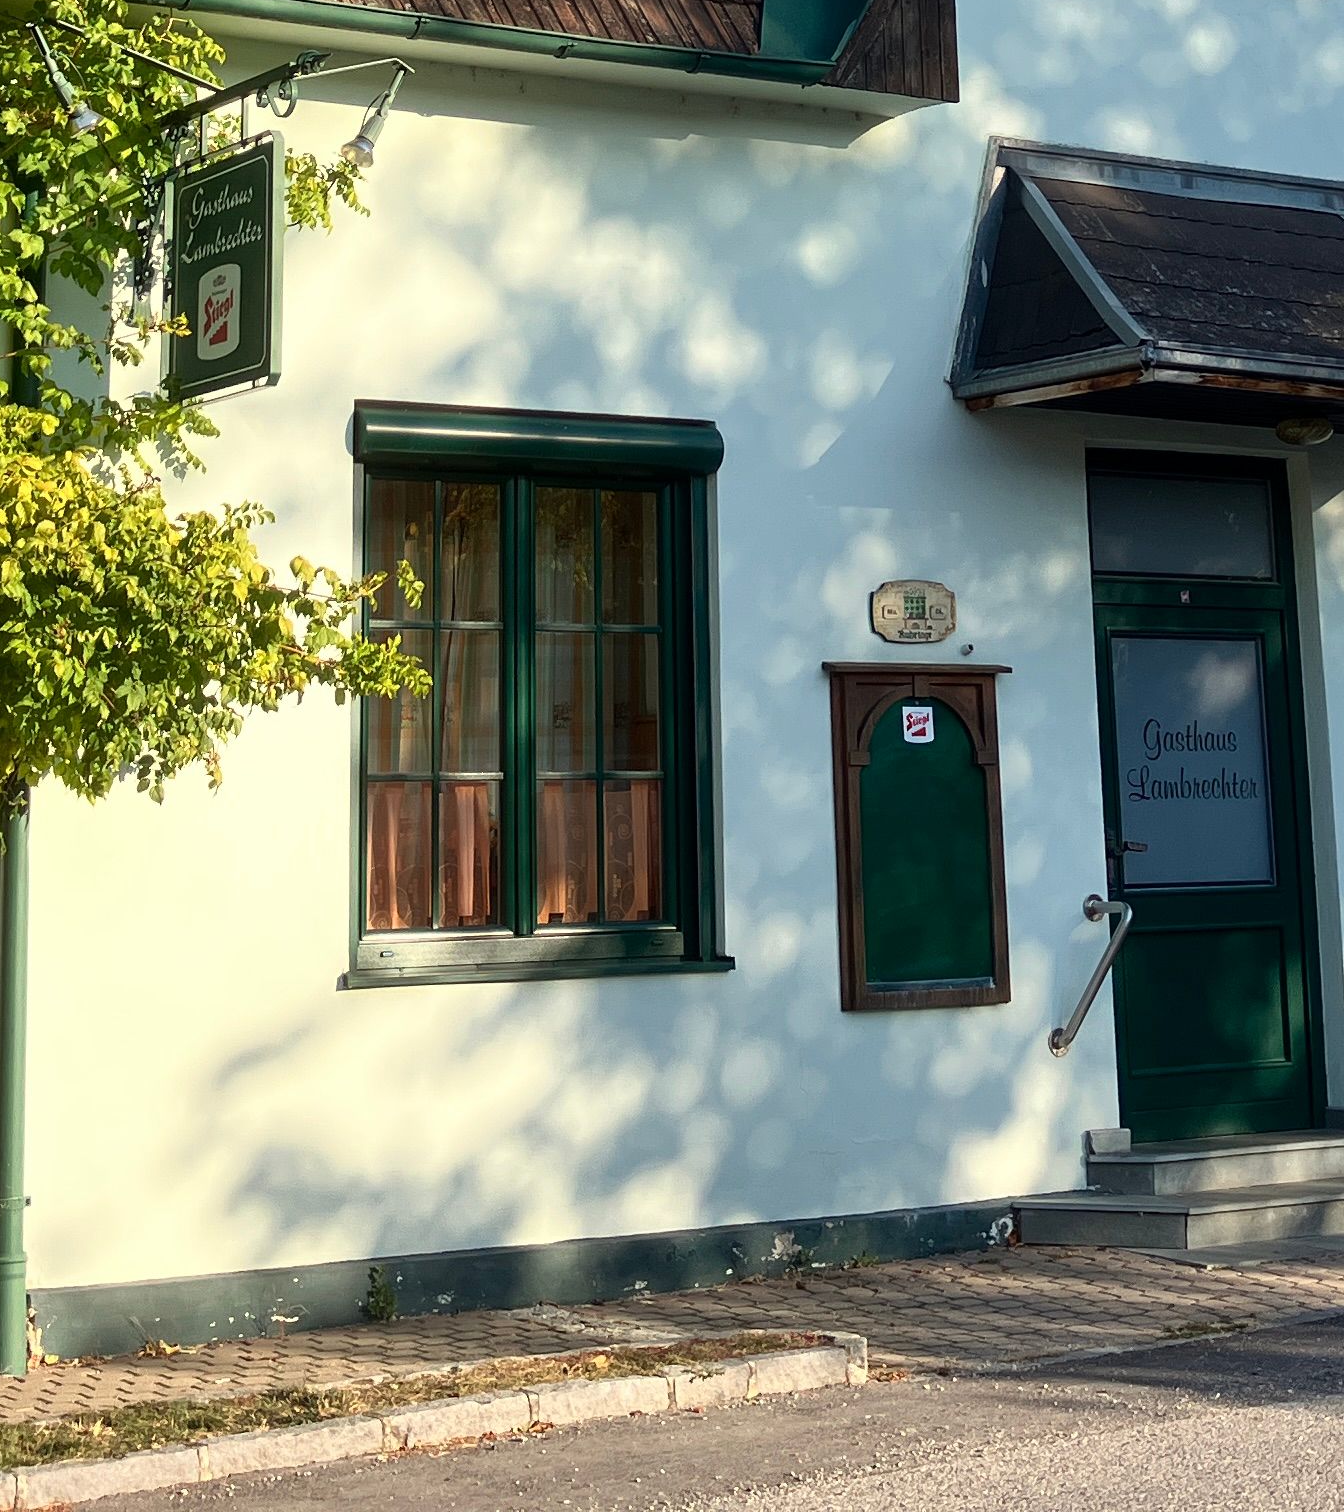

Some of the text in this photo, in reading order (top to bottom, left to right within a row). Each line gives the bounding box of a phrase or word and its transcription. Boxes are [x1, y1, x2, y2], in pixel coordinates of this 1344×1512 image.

[189, 184, 253, 229] Gasthaus
[181, 218, 262, 264] Lambrechter
[203, 288, 234, 338] Stiegl
[1143, 718, 1237, 761] Gasthaus
[1126, 764, 1258, 802] Lambrechter
